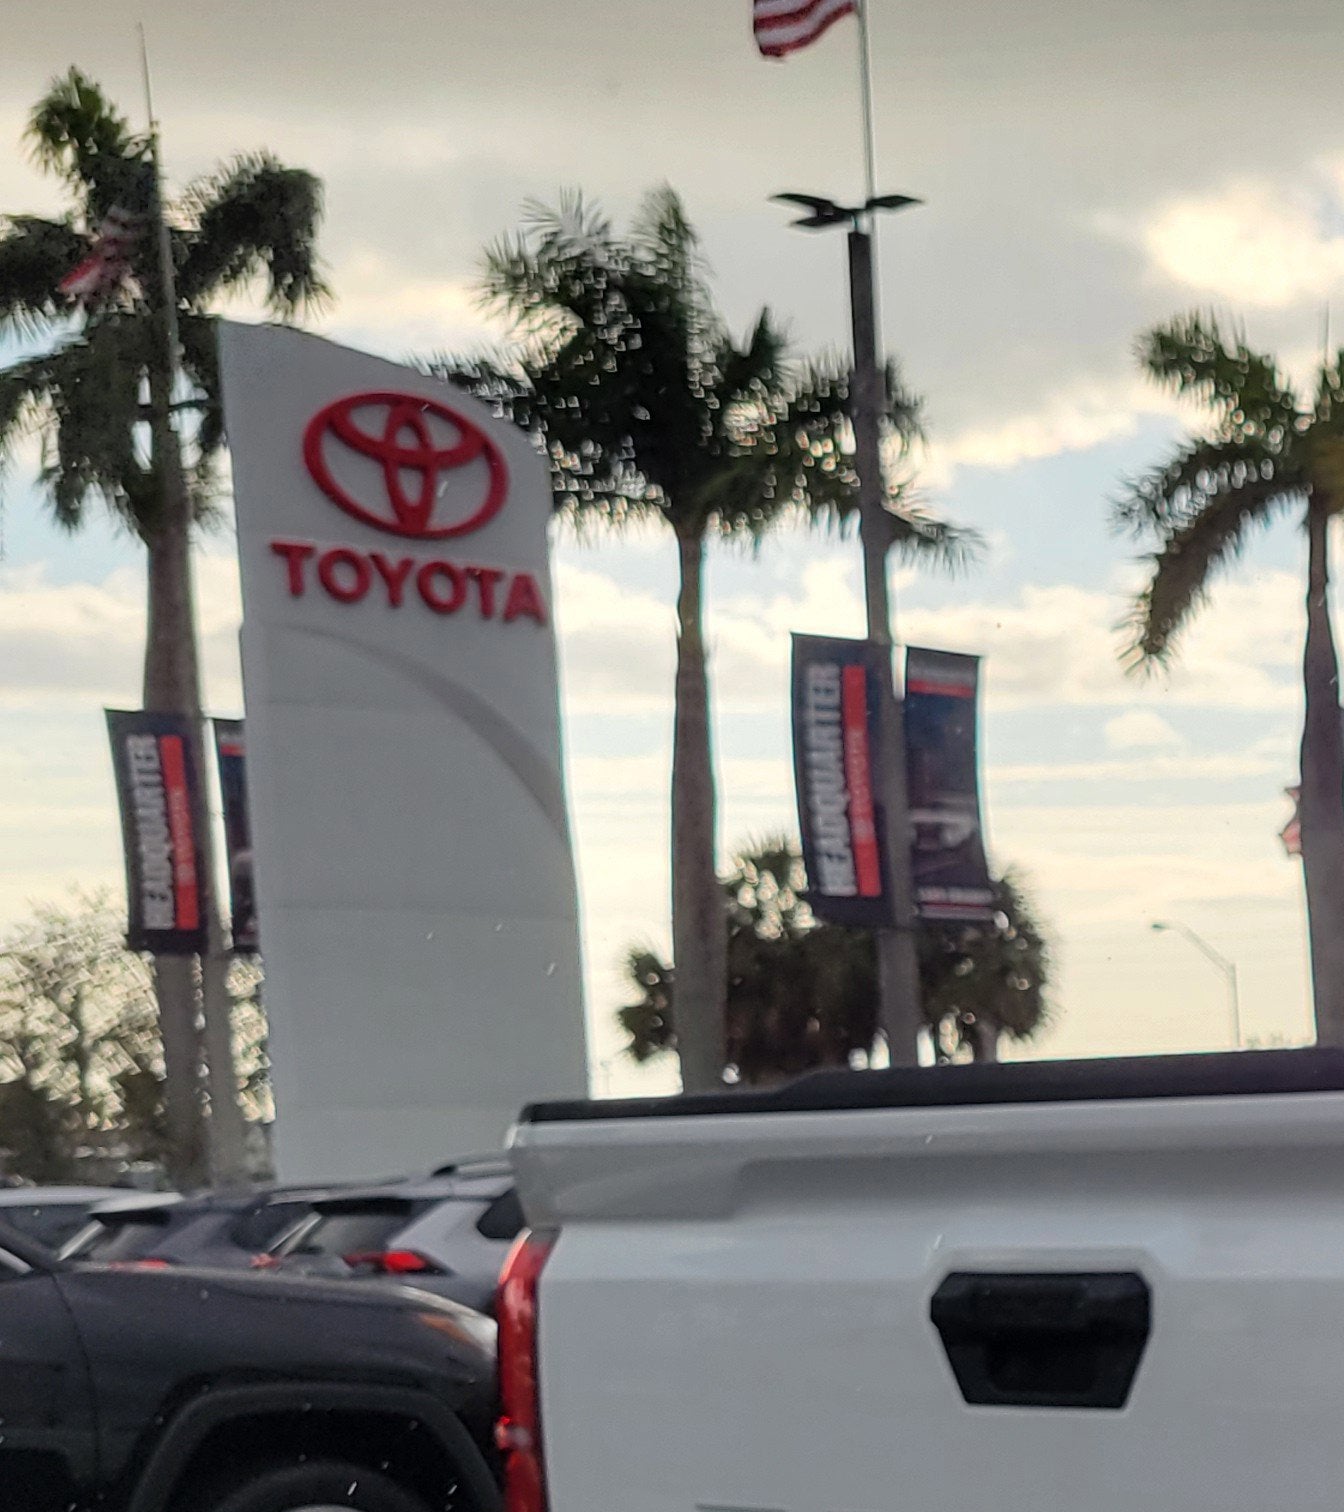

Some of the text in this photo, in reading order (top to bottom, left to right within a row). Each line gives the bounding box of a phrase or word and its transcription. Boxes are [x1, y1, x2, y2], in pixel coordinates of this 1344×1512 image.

[269, 539, 546, 626] TOYOTA
[126, 734, 175, 930] HEADQUARTER
[806, 662, 858, 897] HEADQUARTER
